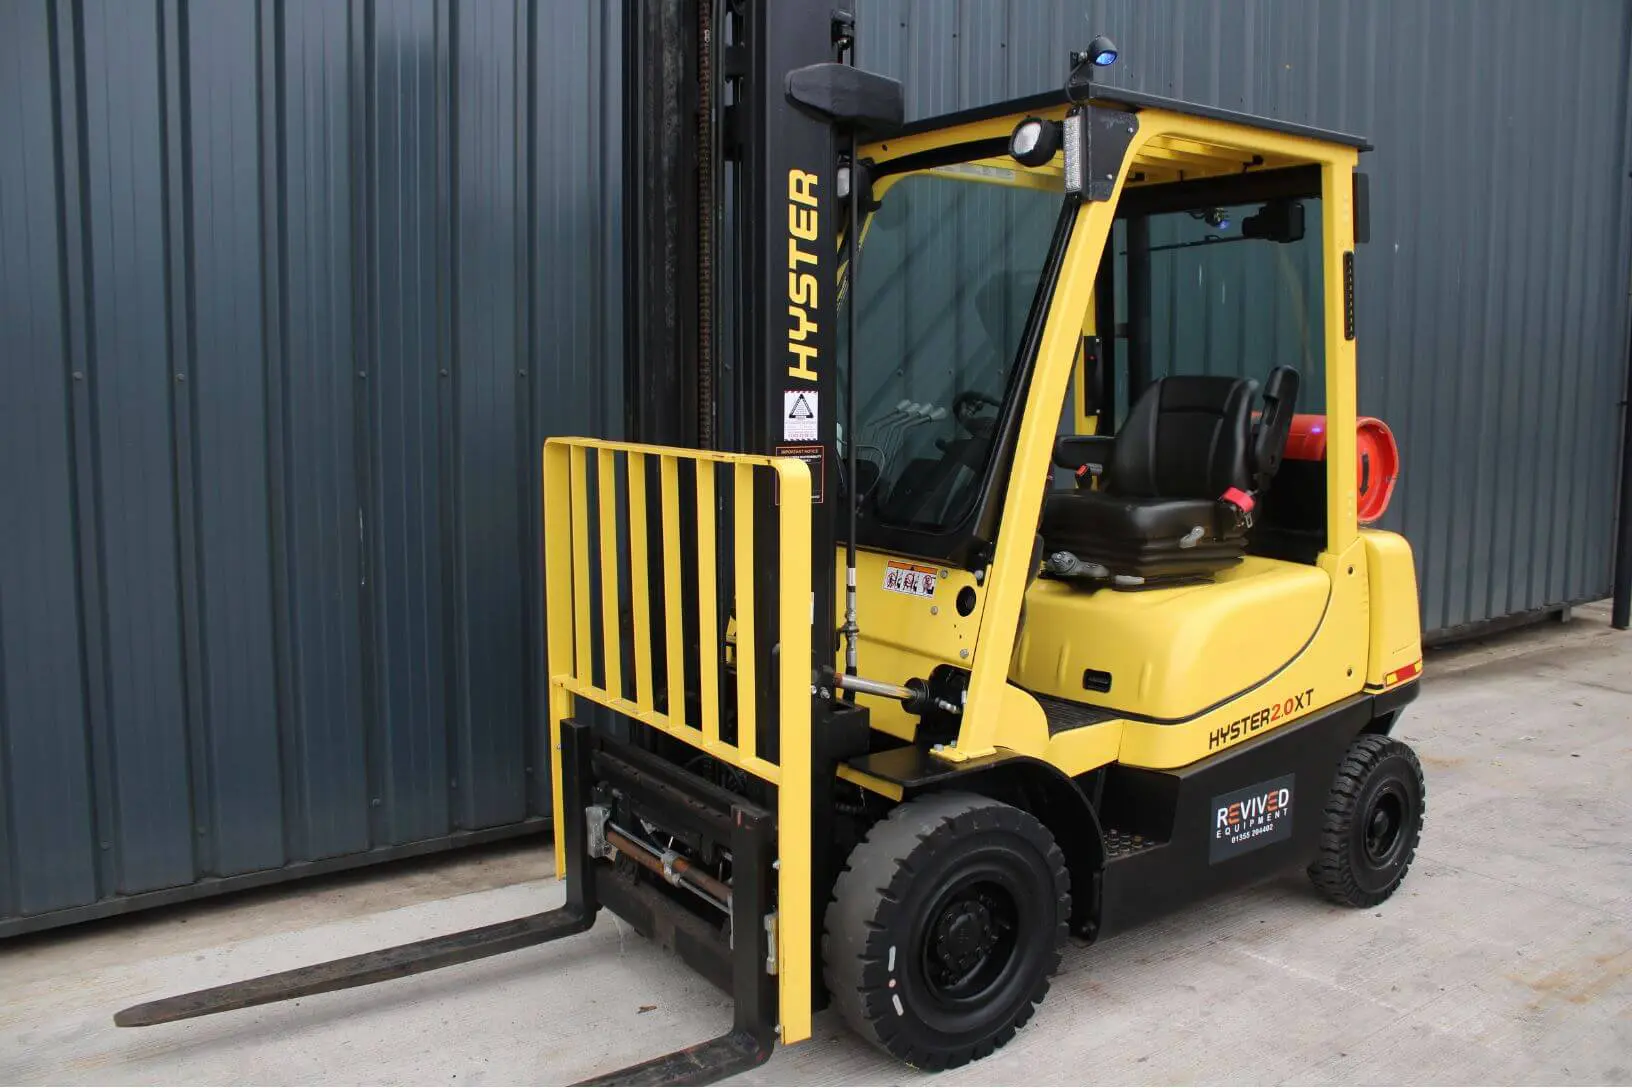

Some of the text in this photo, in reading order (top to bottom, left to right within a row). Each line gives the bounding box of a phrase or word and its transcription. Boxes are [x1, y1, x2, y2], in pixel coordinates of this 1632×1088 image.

[788, 169, 818, 382] HYSTER
[1216, 788, 1289, 828] REVIVED
[1216, 808, 1289, 839] EQUIPMENT
[1231, 832, 1251, 844] 01355
